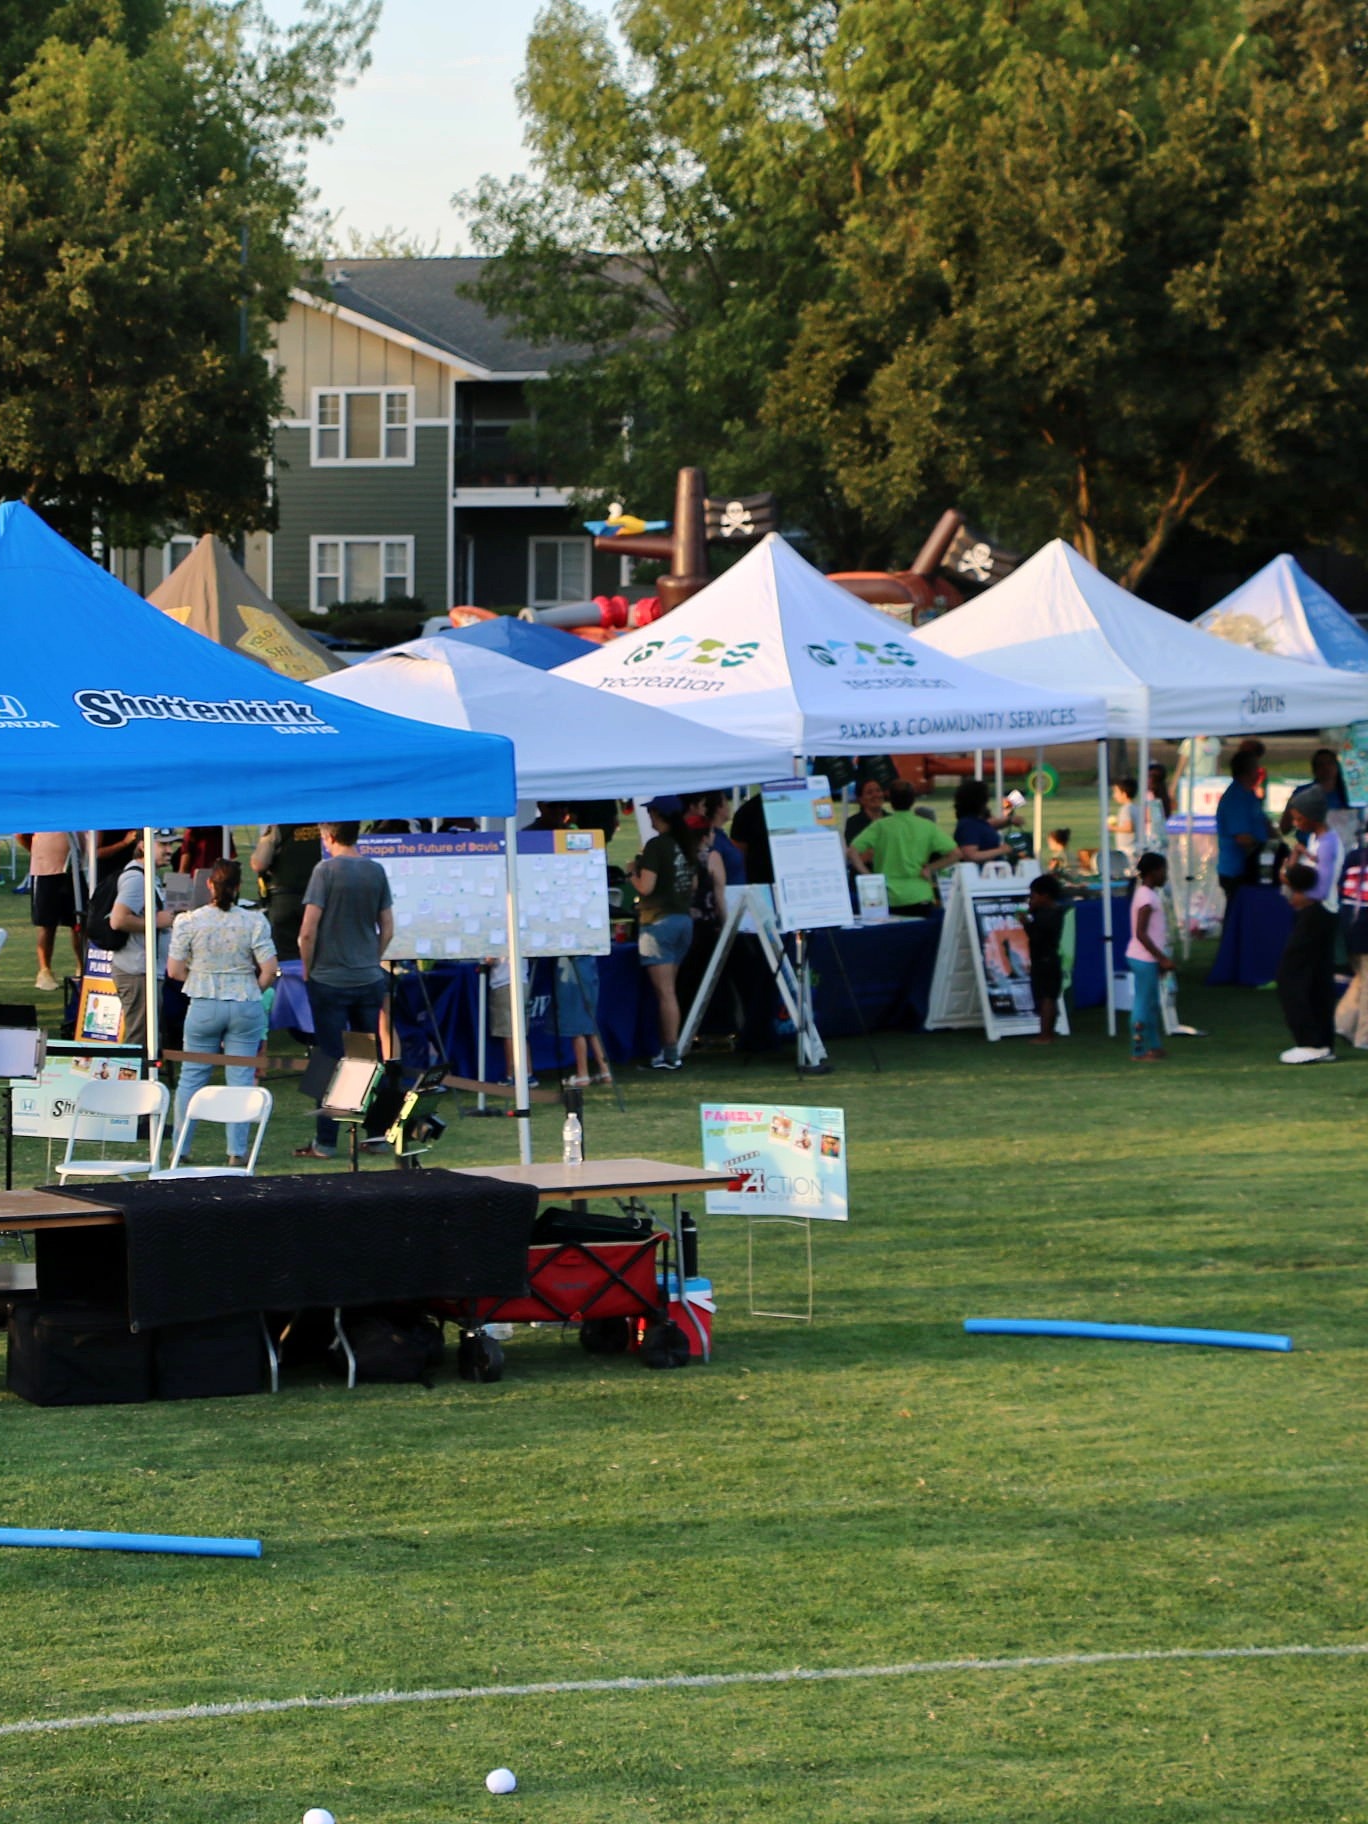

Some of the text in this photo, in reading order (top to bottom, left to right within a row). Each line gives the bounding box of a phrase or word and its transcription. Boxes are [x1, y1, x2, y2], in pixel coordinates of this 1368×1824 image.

[597, 676, 725, 692] recreation
[73, 690, 328, 728] Shottenkirk
[273, 725, 340, 735] DAVIS
[840, 720, 887, 740] PARKS
[907, 712, 1005, 736] COMMUNITY
[1009, 708, 1078, 729] SERVICES
[360, 841, 499, 856] Shape the Future of Davis
[703, 1109, 764, 1122] FAMILY
[742, 1170, 825, 1197] ACTION
